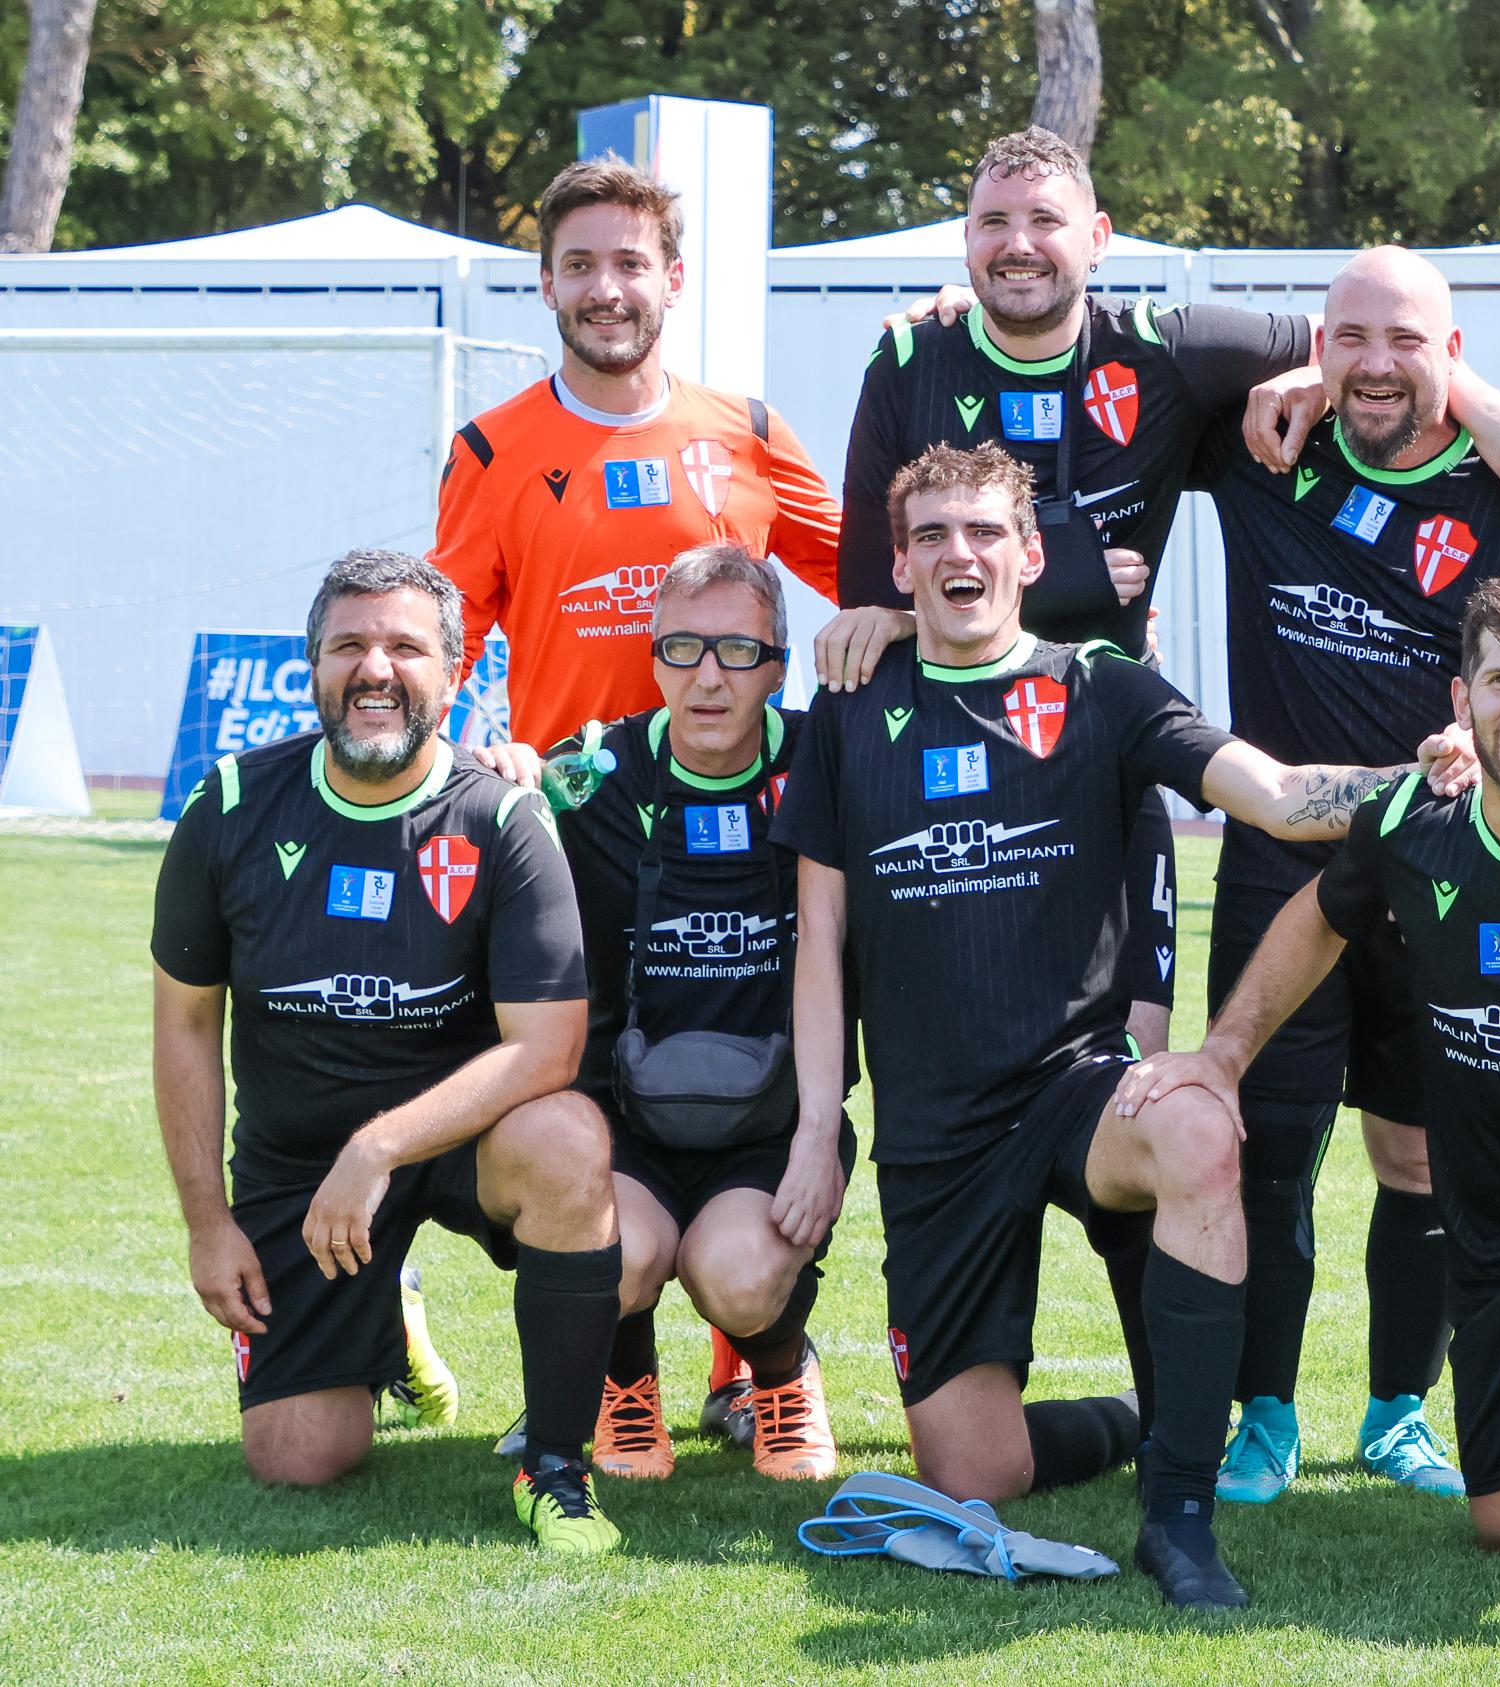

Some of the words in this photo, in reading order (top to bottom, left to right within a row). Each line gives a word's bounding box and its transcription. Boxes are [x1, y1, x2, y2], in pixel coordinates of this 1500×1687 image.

[1089, 500, 1145, 522] PIANTI
[1443, 547, 1466, 561] A.C.P.
[561, 600, 611, 613] NALIN
[1269, 598, 1308, 620] NALIN
[1329, 620, 1349, 631] SRL
[576, 620, 653, 638] www.nalini
[1276, 625, 1410, 667] www.nalinimpianti.it
[1038, 703, 1063, 713] A.C.P.
[449, 866, 474, 874] A.C.P.
[874, 858, 924, 876] NALIN
[950, 857, 971, 868] SRL
[992, 844, 1074, 863] IMPIANTI
[891, 871, 1039, 900] www.nalinimpianti.it
[1152, 853, 1174, 929] 4
[707, 945, 726, 954] SRL
[644, 957, 780, 979] www.nalinimpianti.i
[268, 1001, 327, 1014] NALIN
[355, 1008, 375, 1016] SRL
[398, 991, 475, 1017] IMPIANTI
[1433, 1017, 1478, 1044] NALIN
